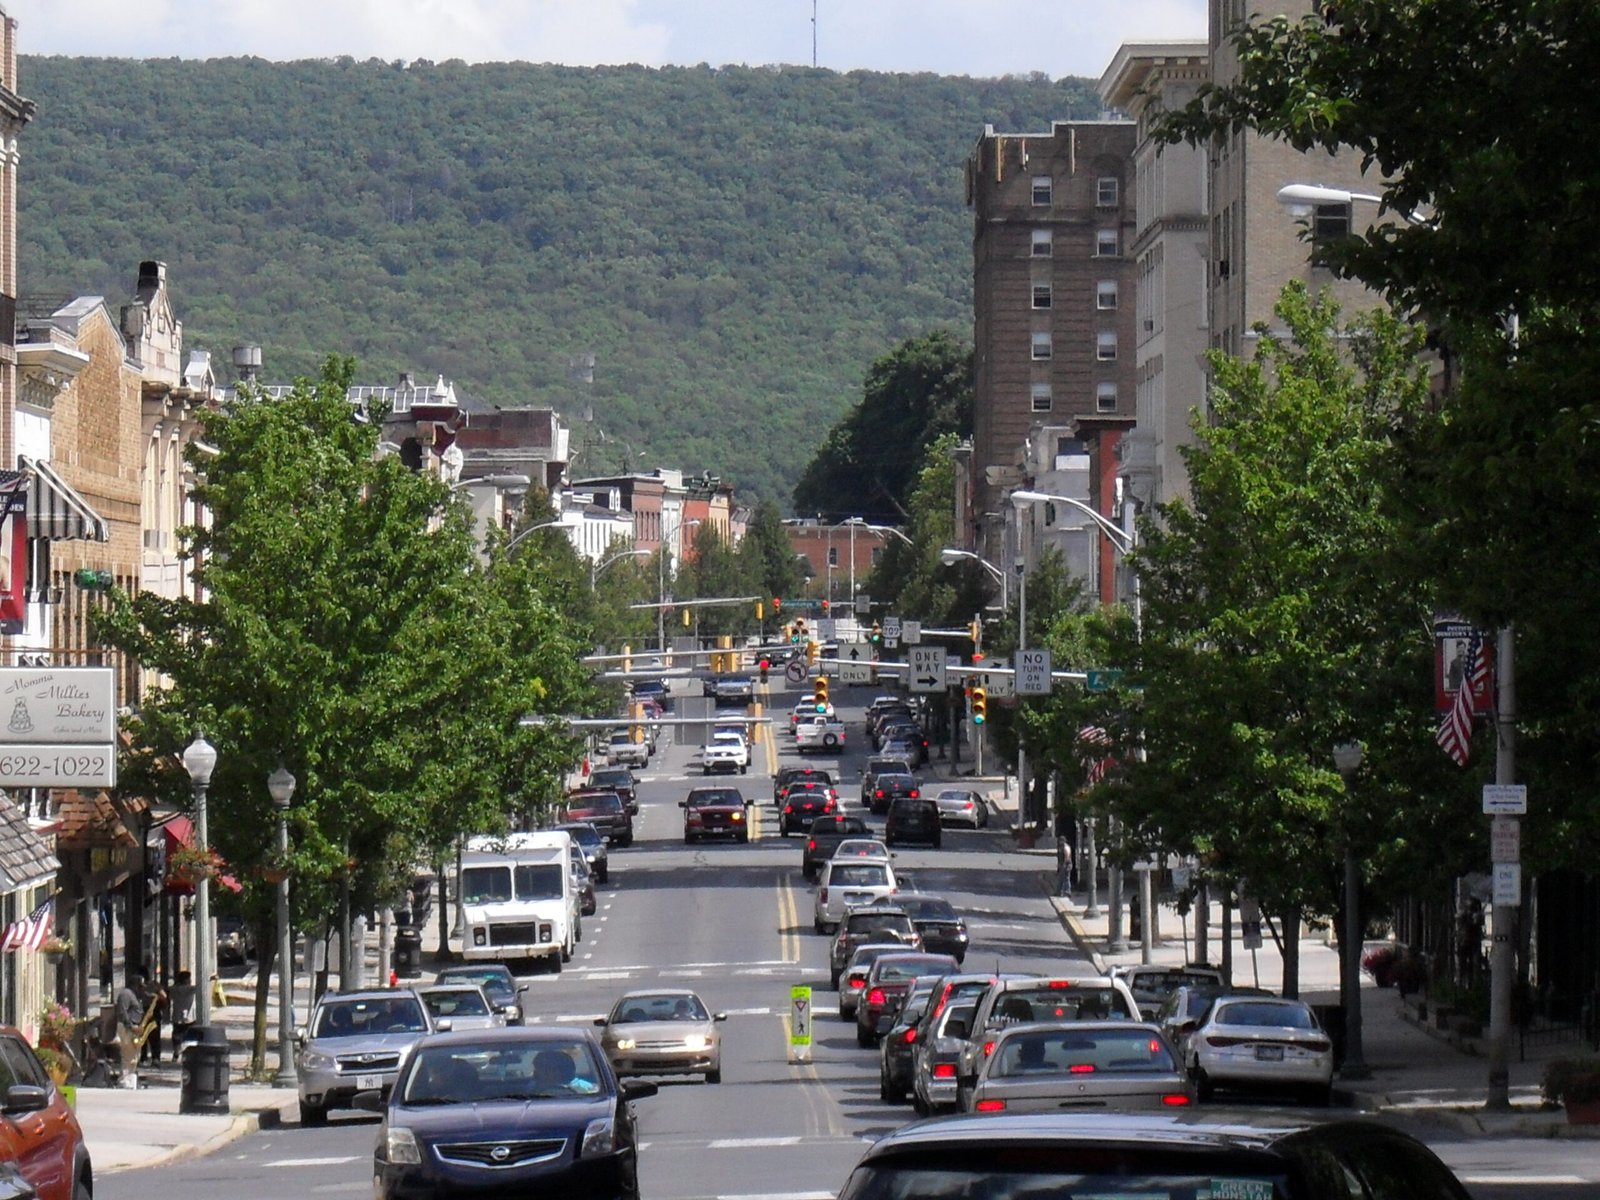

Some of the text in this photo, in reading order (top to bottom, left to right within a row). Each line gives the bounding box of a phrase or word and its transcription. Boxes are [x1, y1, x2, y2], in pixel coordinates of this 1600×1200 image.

[915, 652, 939, 661] ONE
[1024, 654, 1043, 664] NO
[915, 663, 940, 673] WAY
[843, 671, 867, 680] ONLY
[5, 675, 53, 694] Momma
[36, 685, 89, 699] Millies
[987, 687, 1005, 695] NLY
[56, 704, 105, 723] Bakery
[0, 756, 104, 776] 622-1022
[1220, 1182, 1264, 1192] GREEN
[1213, 1190, 1273, 1200] MONSTAH
